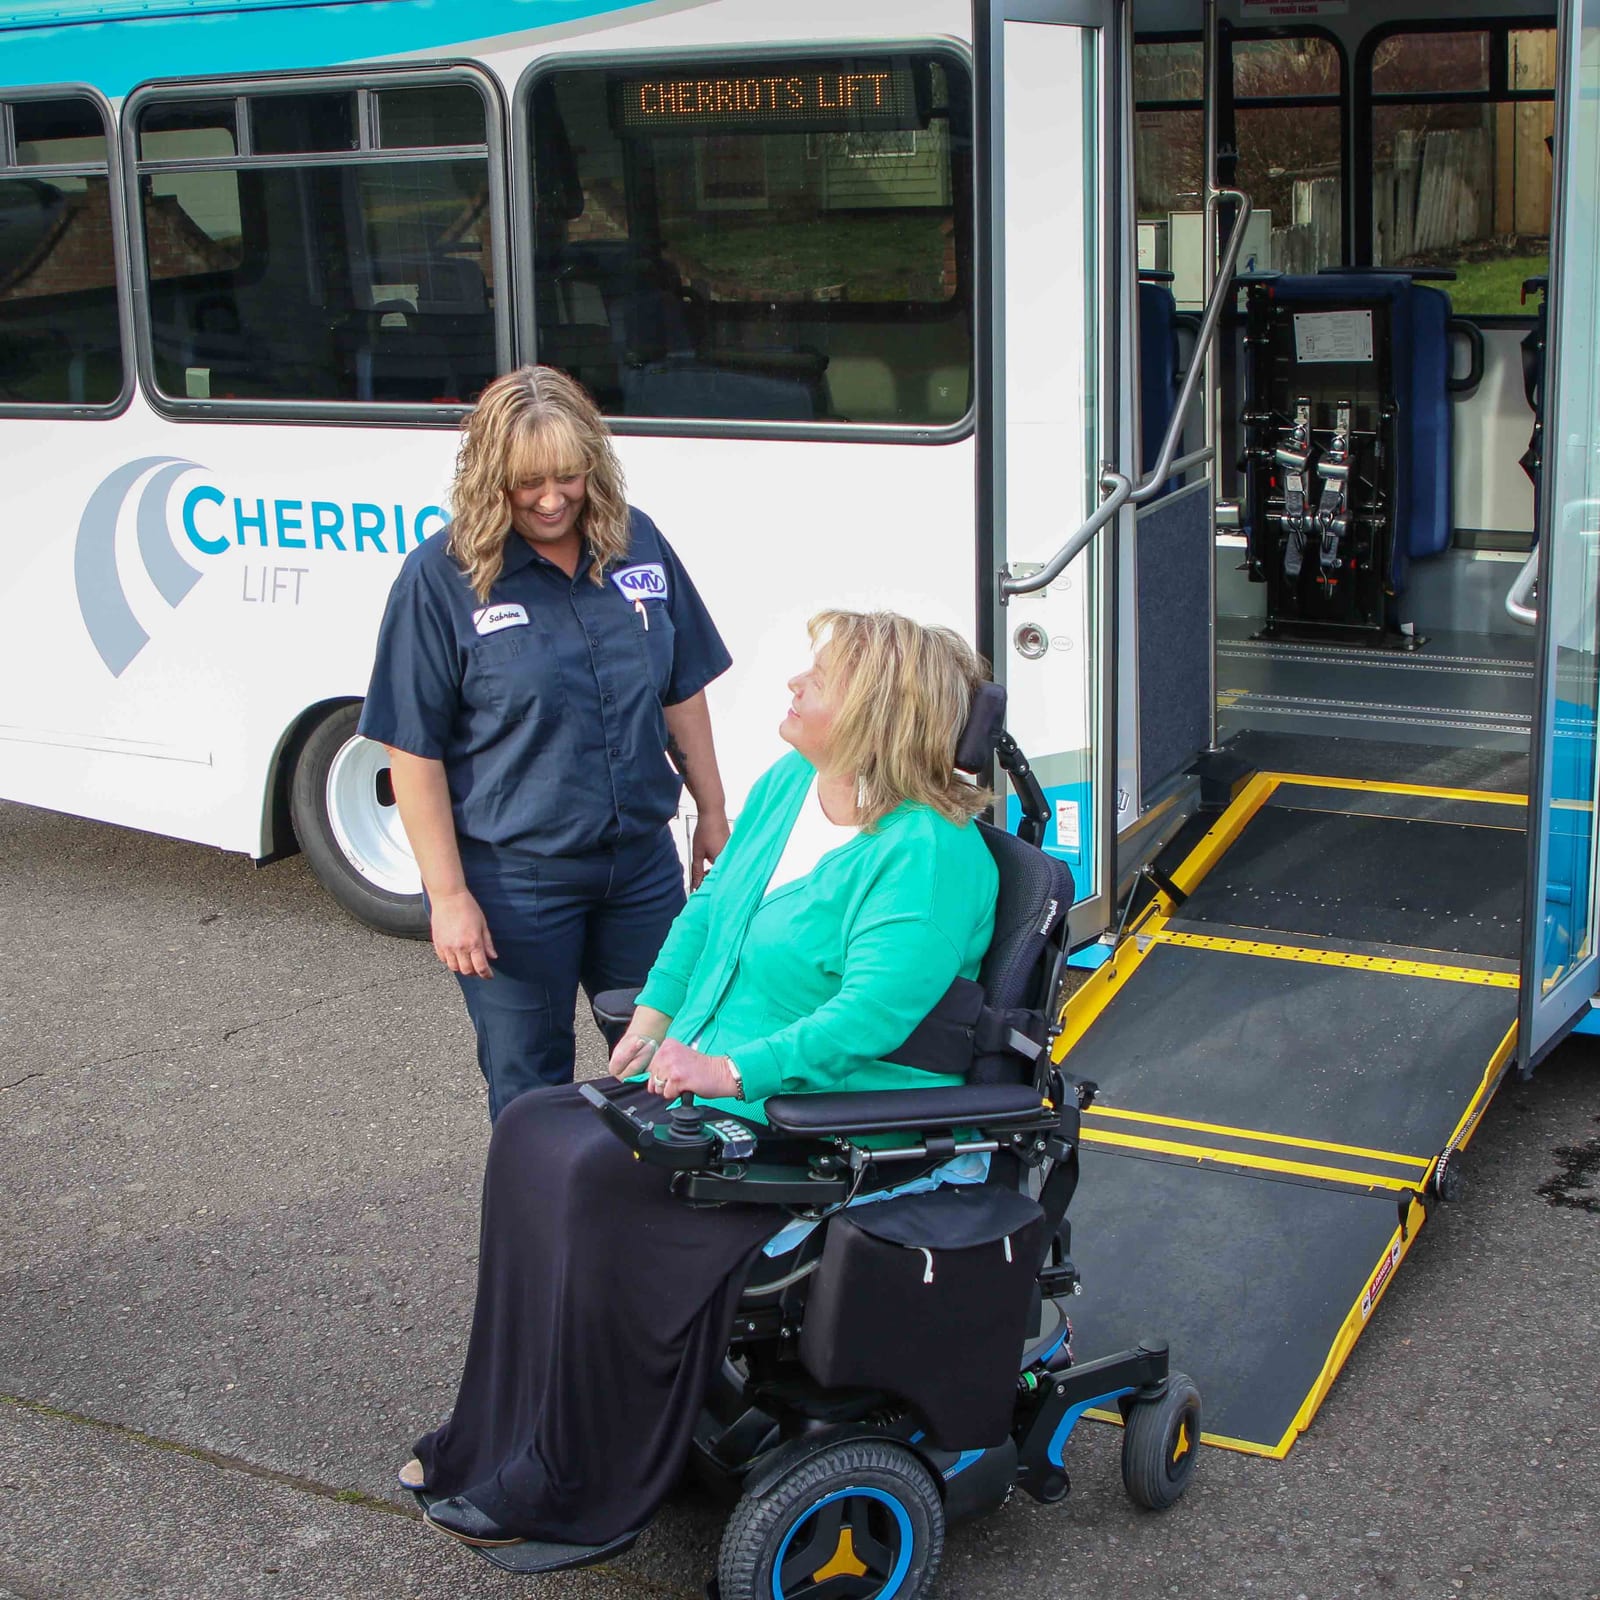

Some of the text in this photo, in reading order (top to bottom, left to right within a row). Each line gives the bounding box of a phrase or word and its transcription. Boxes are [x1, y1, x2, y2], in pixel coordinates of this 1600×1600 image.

[640, 73, 888, 113] CHERRIOTS LIFT
[182, 485, 454, 554] CHERRIO
[242, 565, 310, 605] LIFT
[488, 611, 521, 624] Sabrina
[1040, 900, 1059, 936] permobil
